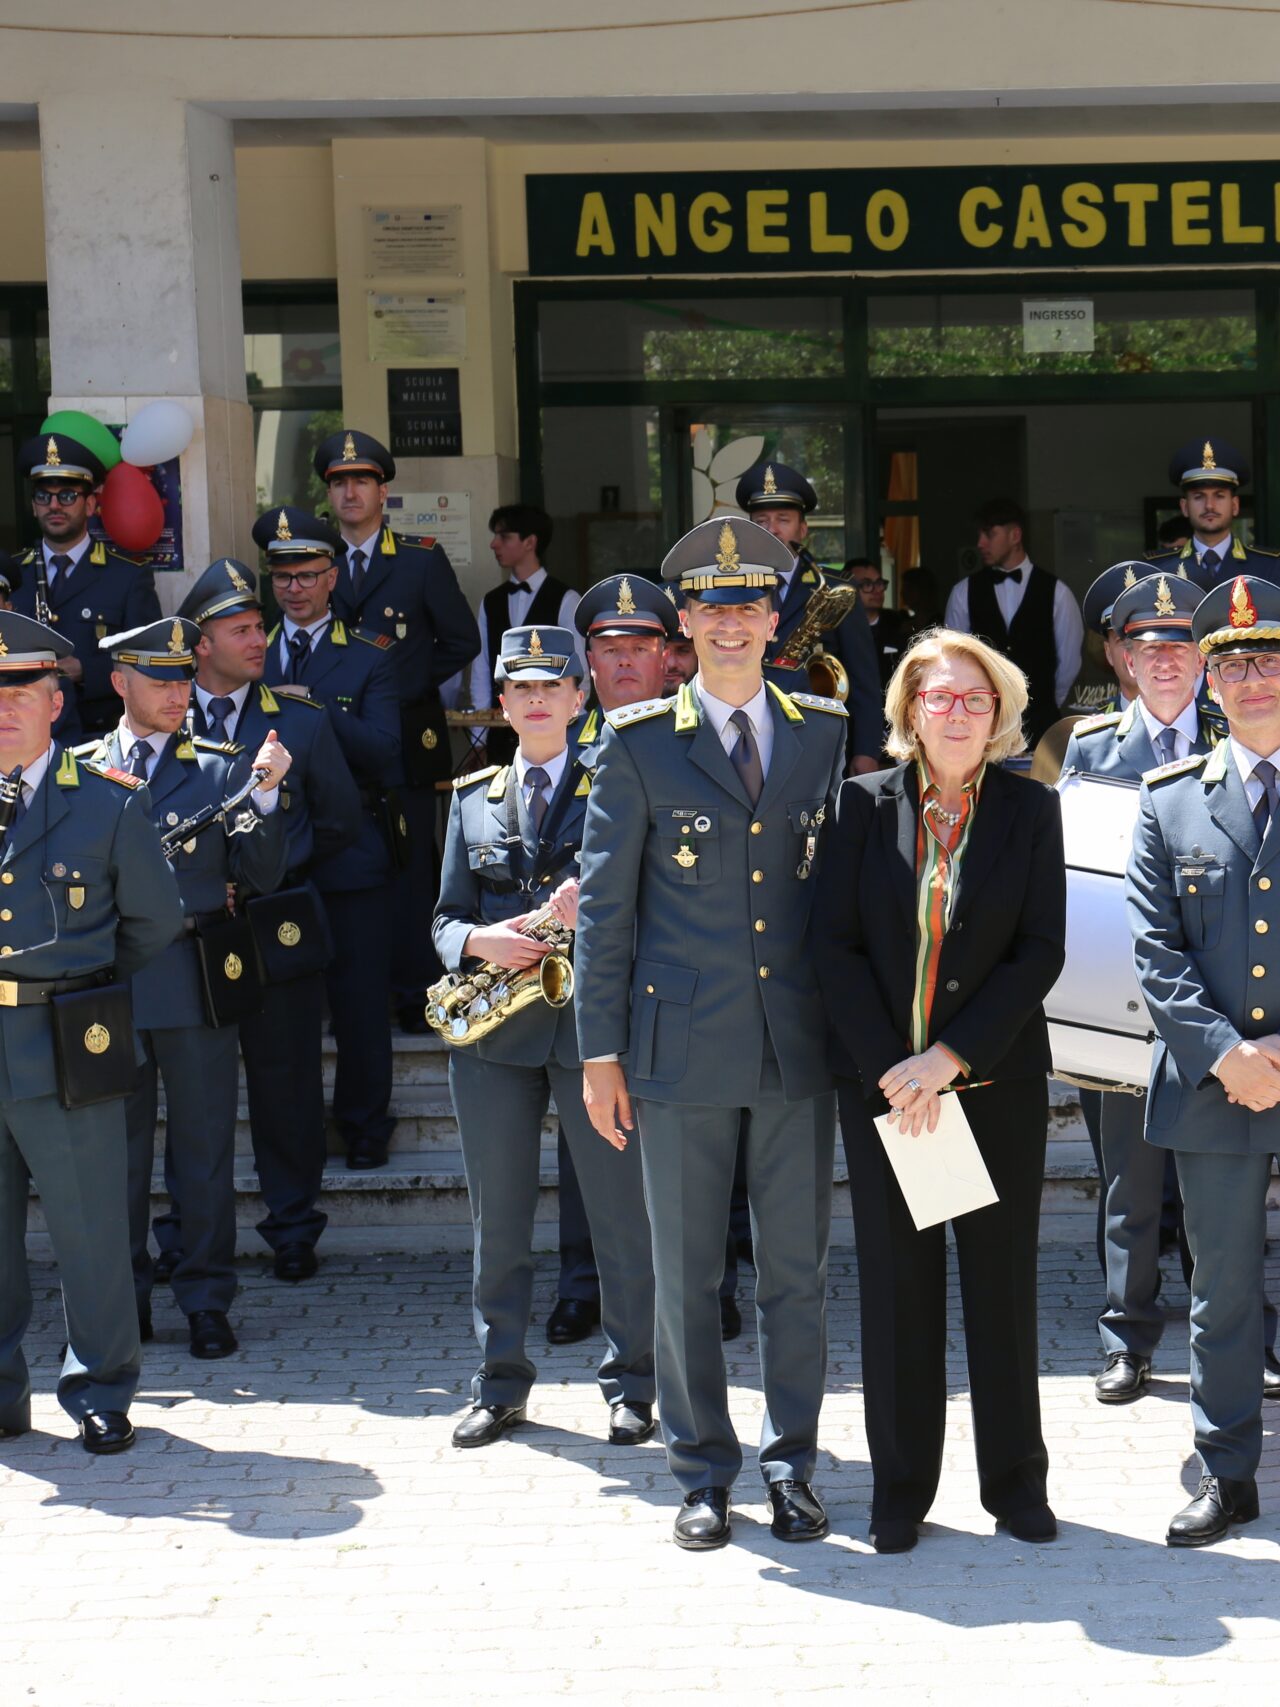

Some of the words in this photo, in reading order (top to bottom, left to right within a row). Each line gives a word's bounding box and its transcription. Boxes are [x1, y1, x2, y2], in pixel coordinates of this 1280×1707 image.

[576, 189, 909, 258] ANGELO
[1029, 309, 1087, 321] INGRESSO
[405, 376, 443, 387] SCUOLA
[402, 392, 447, 402] MATERNA
[407, 420, 446, 431] SCUOLA
[395, 435, 457, 447] ELEMENTARE
